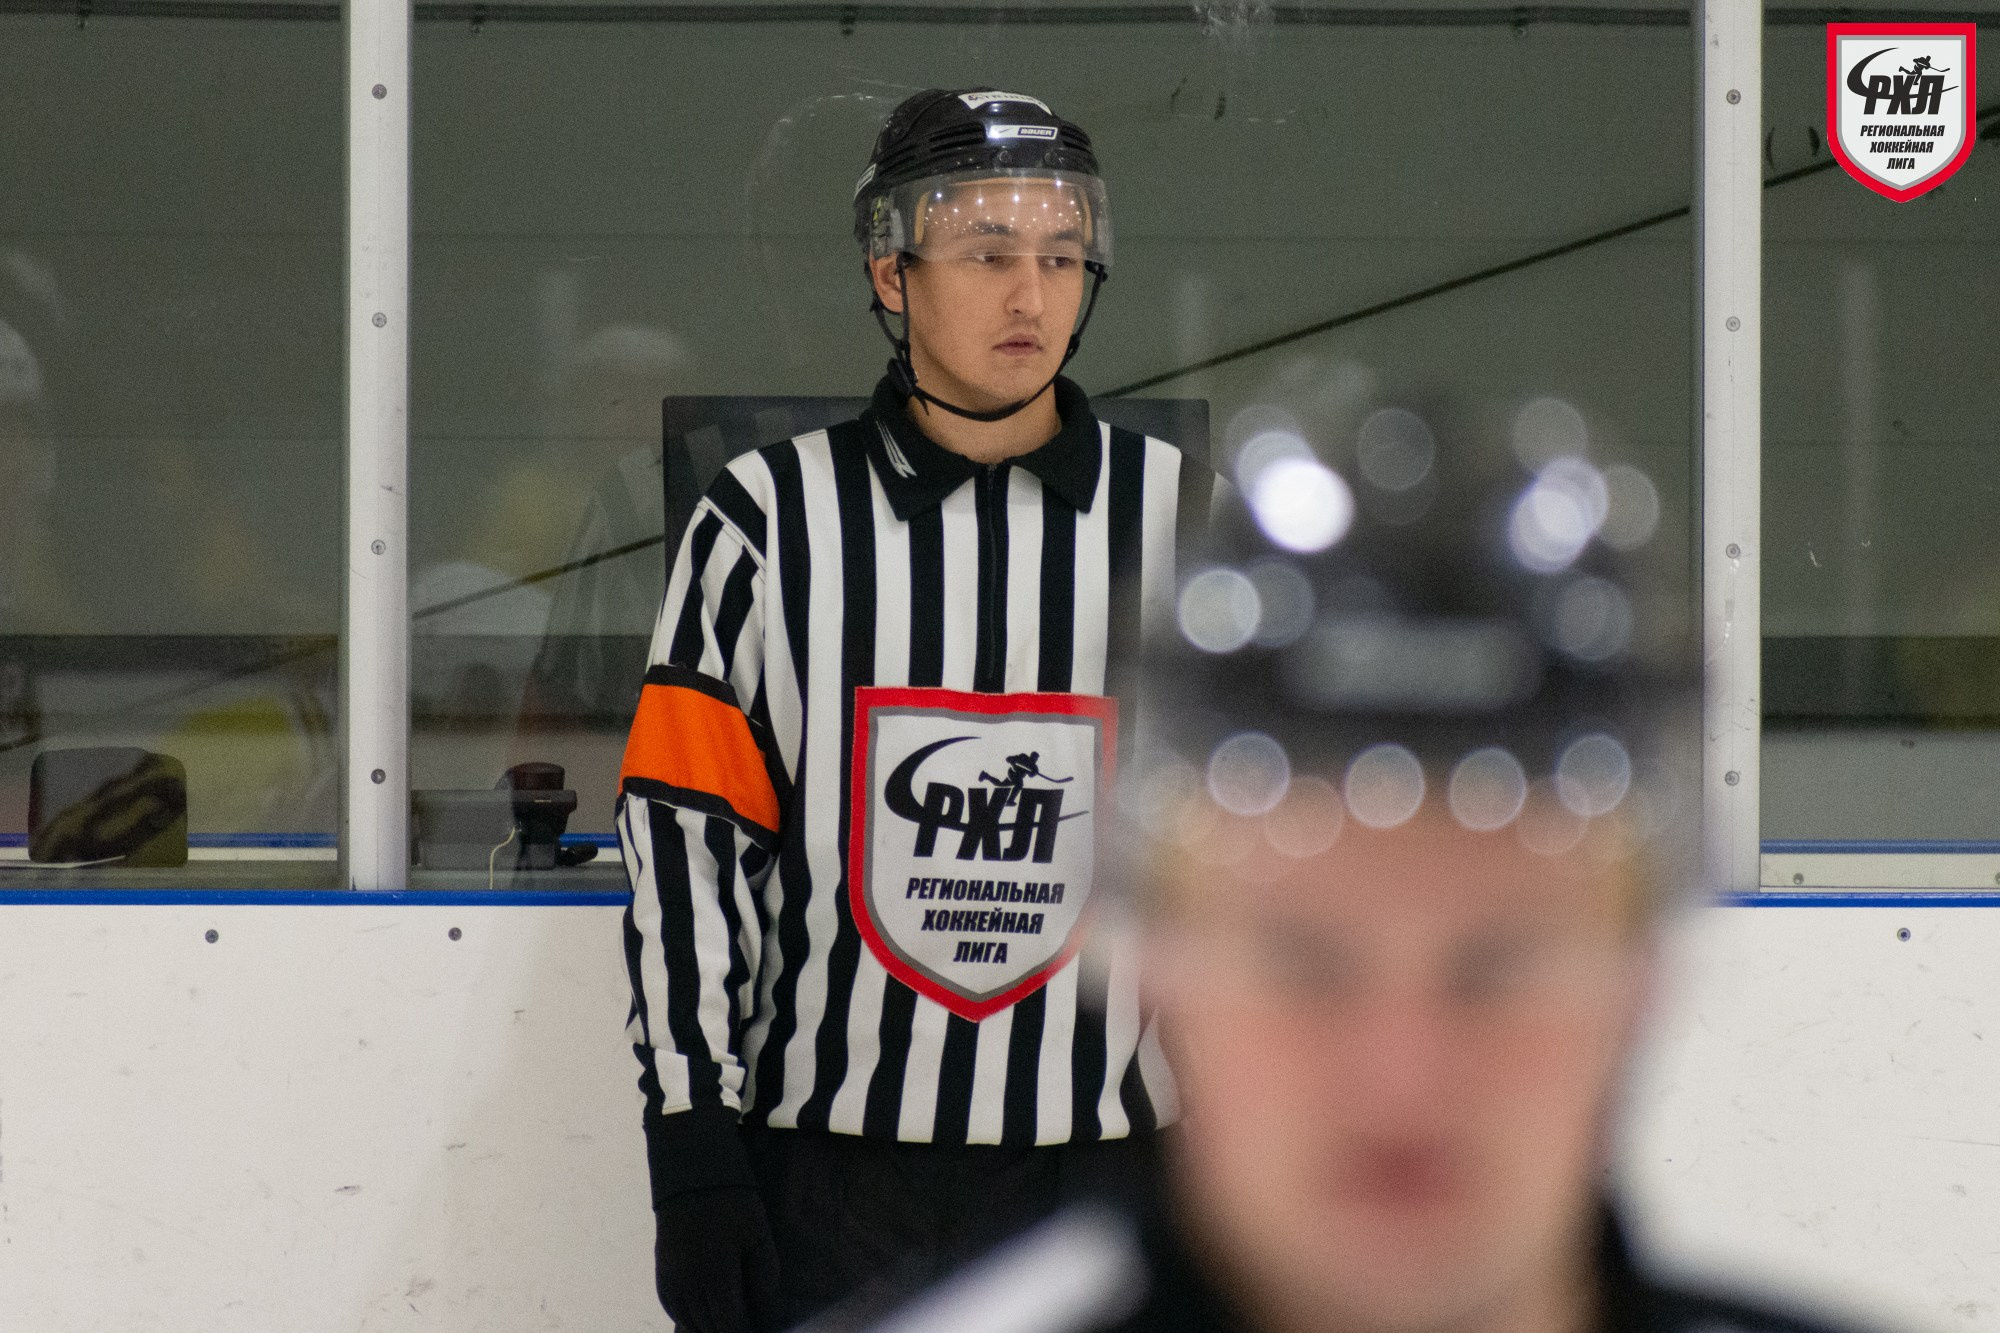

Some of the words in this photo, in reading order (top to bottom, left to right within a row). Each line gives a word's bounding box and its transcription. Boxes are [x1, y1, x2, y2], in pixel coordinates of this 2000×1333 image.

[1020, 128, 1053, 136] BAUER
[913, 782, 1064, 864] РХЛ
[905, 877, 1065, 905] РЕГИОНАЛЬНАЯ
[921, 907, 1044, 935] ХОККЕЙНАЯ
[953, 941, 1009, 964] ЛИГА
